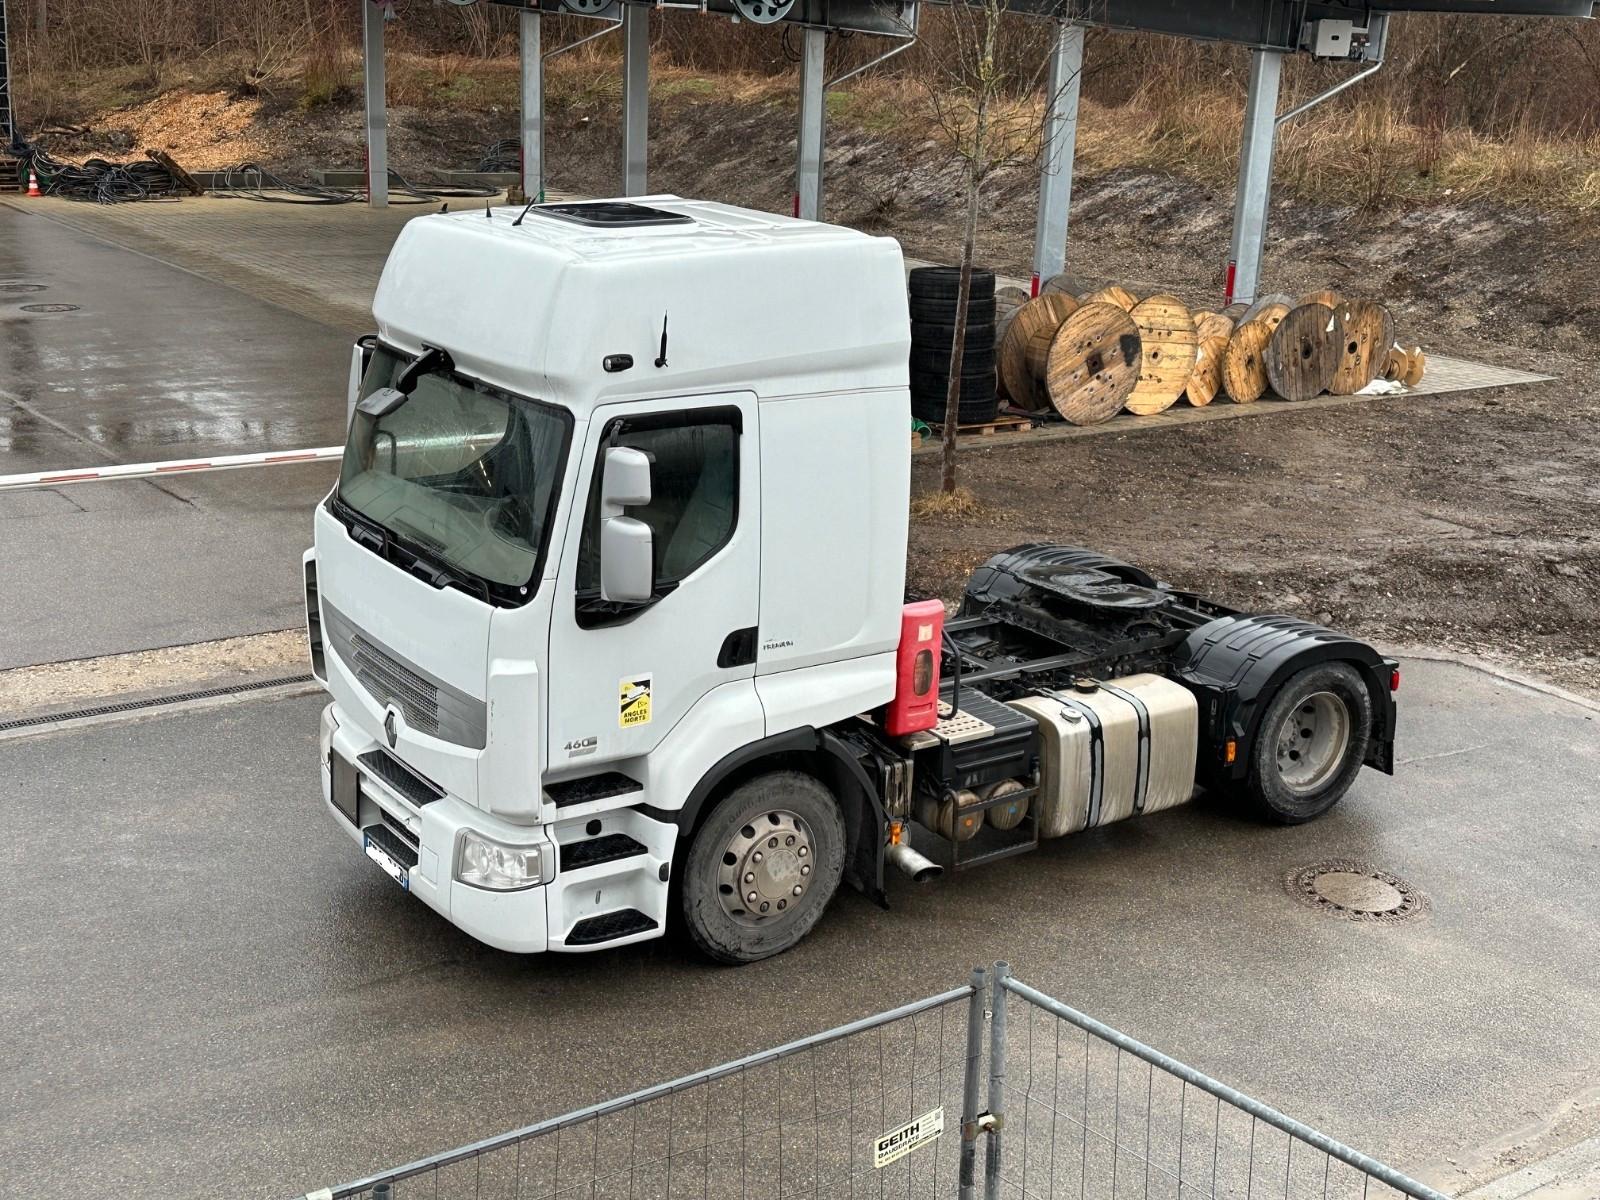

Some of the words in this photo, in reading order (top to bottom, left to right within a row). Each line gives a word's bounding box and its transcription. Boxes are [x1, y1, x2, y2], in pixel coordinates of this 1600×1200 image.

[624, 709, 647, 718] ANGLES
[624, 715, 646, 724] MORTS
[564, 739, 590, 750] 460
[878, 1122, 920, 1151] GEITH
